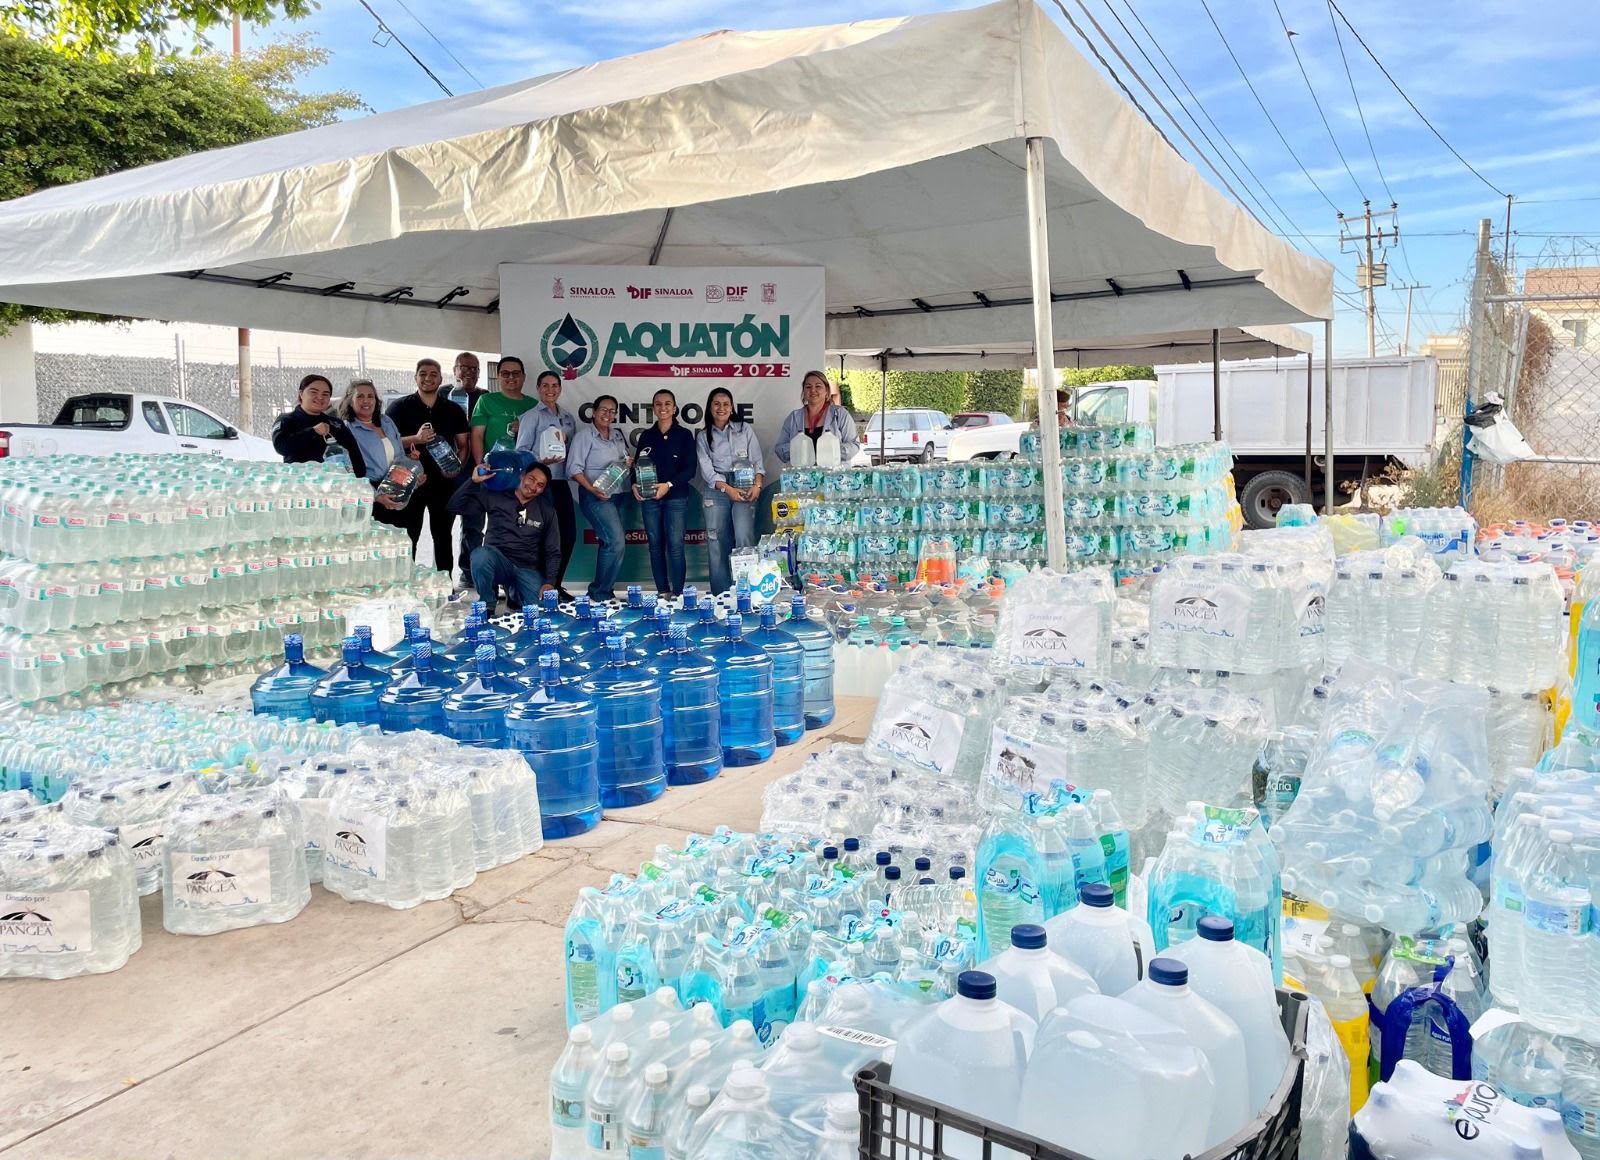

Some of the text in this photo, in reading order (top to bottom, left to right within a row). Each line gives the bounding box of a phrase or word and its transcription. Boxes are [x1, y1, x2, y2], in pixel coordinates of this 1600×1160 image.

[570, 287, 615, 295] SINALOA
[629, 287, 694, 299] DIF SINALOA
[726, 286, 748, 296] DIF
[598, 314, 790, 376] AQUATÓN
[672, 366, 690, 377] DIF
[733, 364, 790, 377] 2025
[578, 402, 704, 424] CNTO
[761, 577, 779, 593] ciel
[1174, 607, 1218, 620] PANGEA
[1022, 640, 1067, 650] PANGEA
[891, 728, 928, 751] PANGEA
[335, 839, 367, 857] PANGEA
[186, 881, 237, 894] PANGEA
[0, 925, 53, 937] PANGEA
